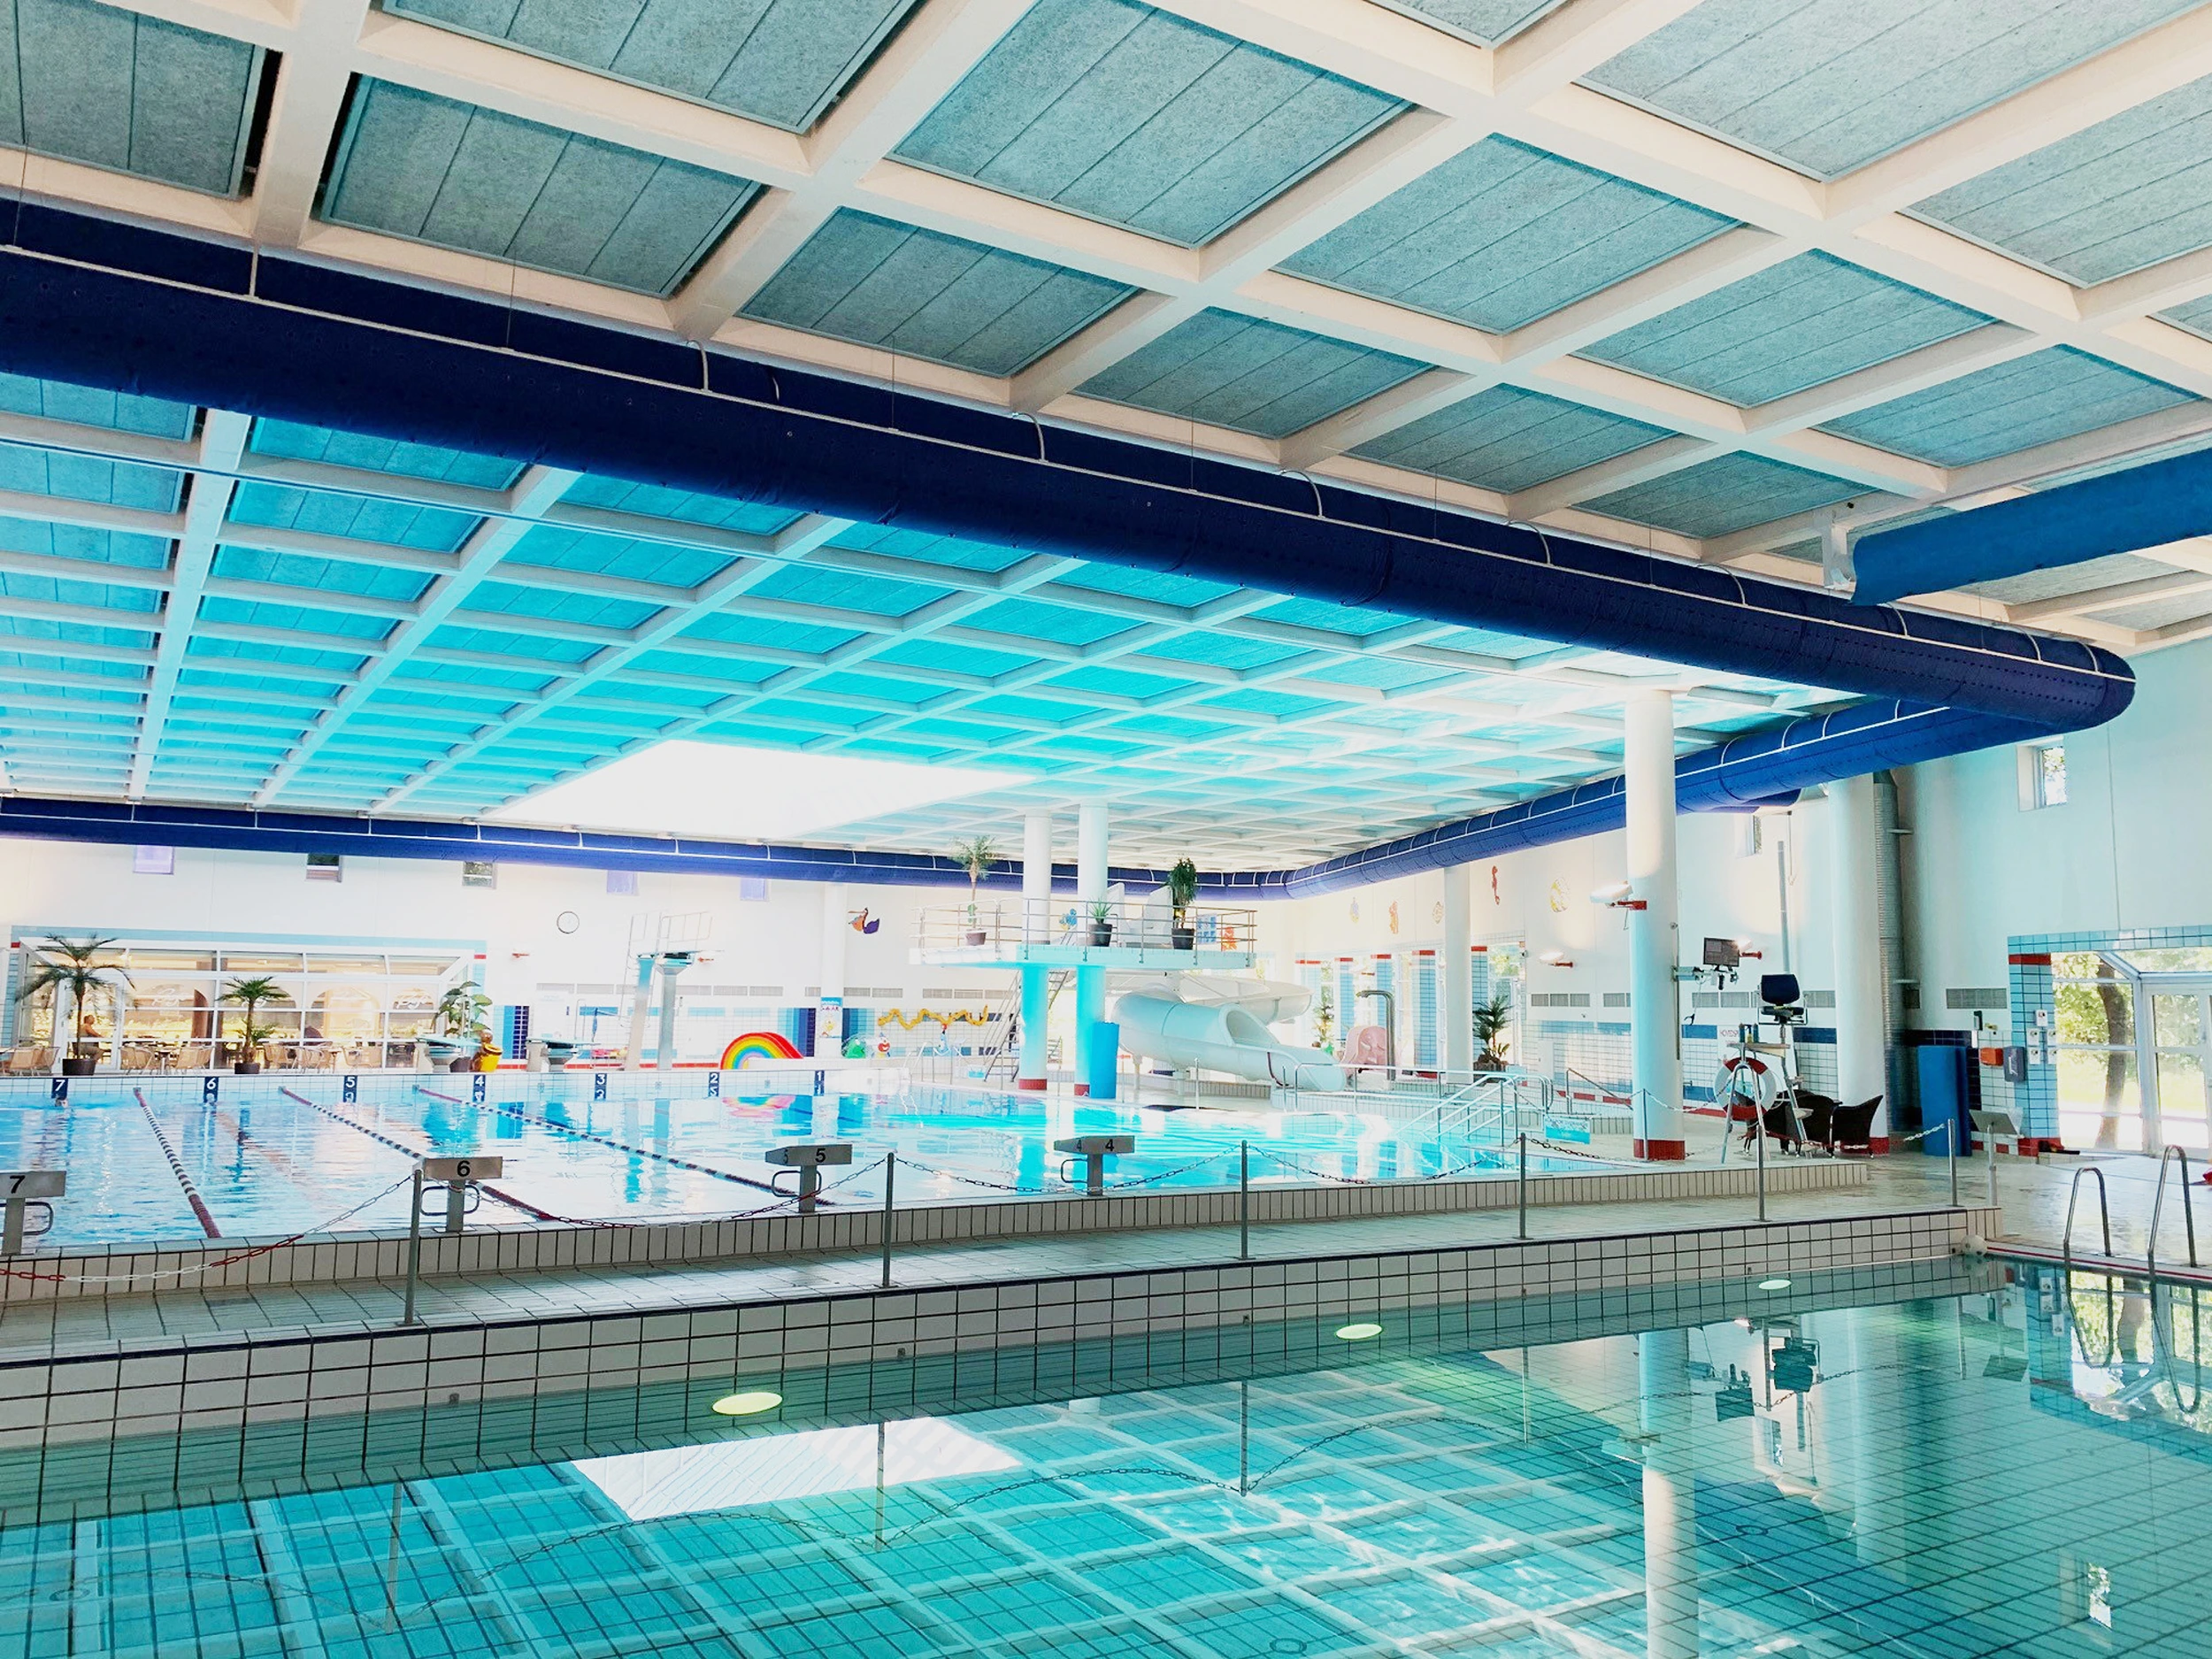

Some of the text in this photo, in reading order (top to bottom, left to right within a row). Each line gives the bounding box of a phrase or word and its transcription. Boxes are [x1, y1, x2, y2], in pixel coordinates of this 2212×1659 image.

[345, 1076, 356, 1088] 5
[474, 1076, 485, 1087] 4
[596, 1073, 605, 1085] 3
[710, 1072, 718, 1084] 2
[817, 1071, 821, 1081] 1
[55, 1079, 65, 1092] 7
[206, 1077, 216, 1089] 6
[1077, 1139, 1082, 1151] 4
[1105, 1139, 1115, 1152] 4
[815, 1148, 826, 1163] 5
[457, 1160, 471, 1178] 6
[9, 1175, 26, 1194] 7
